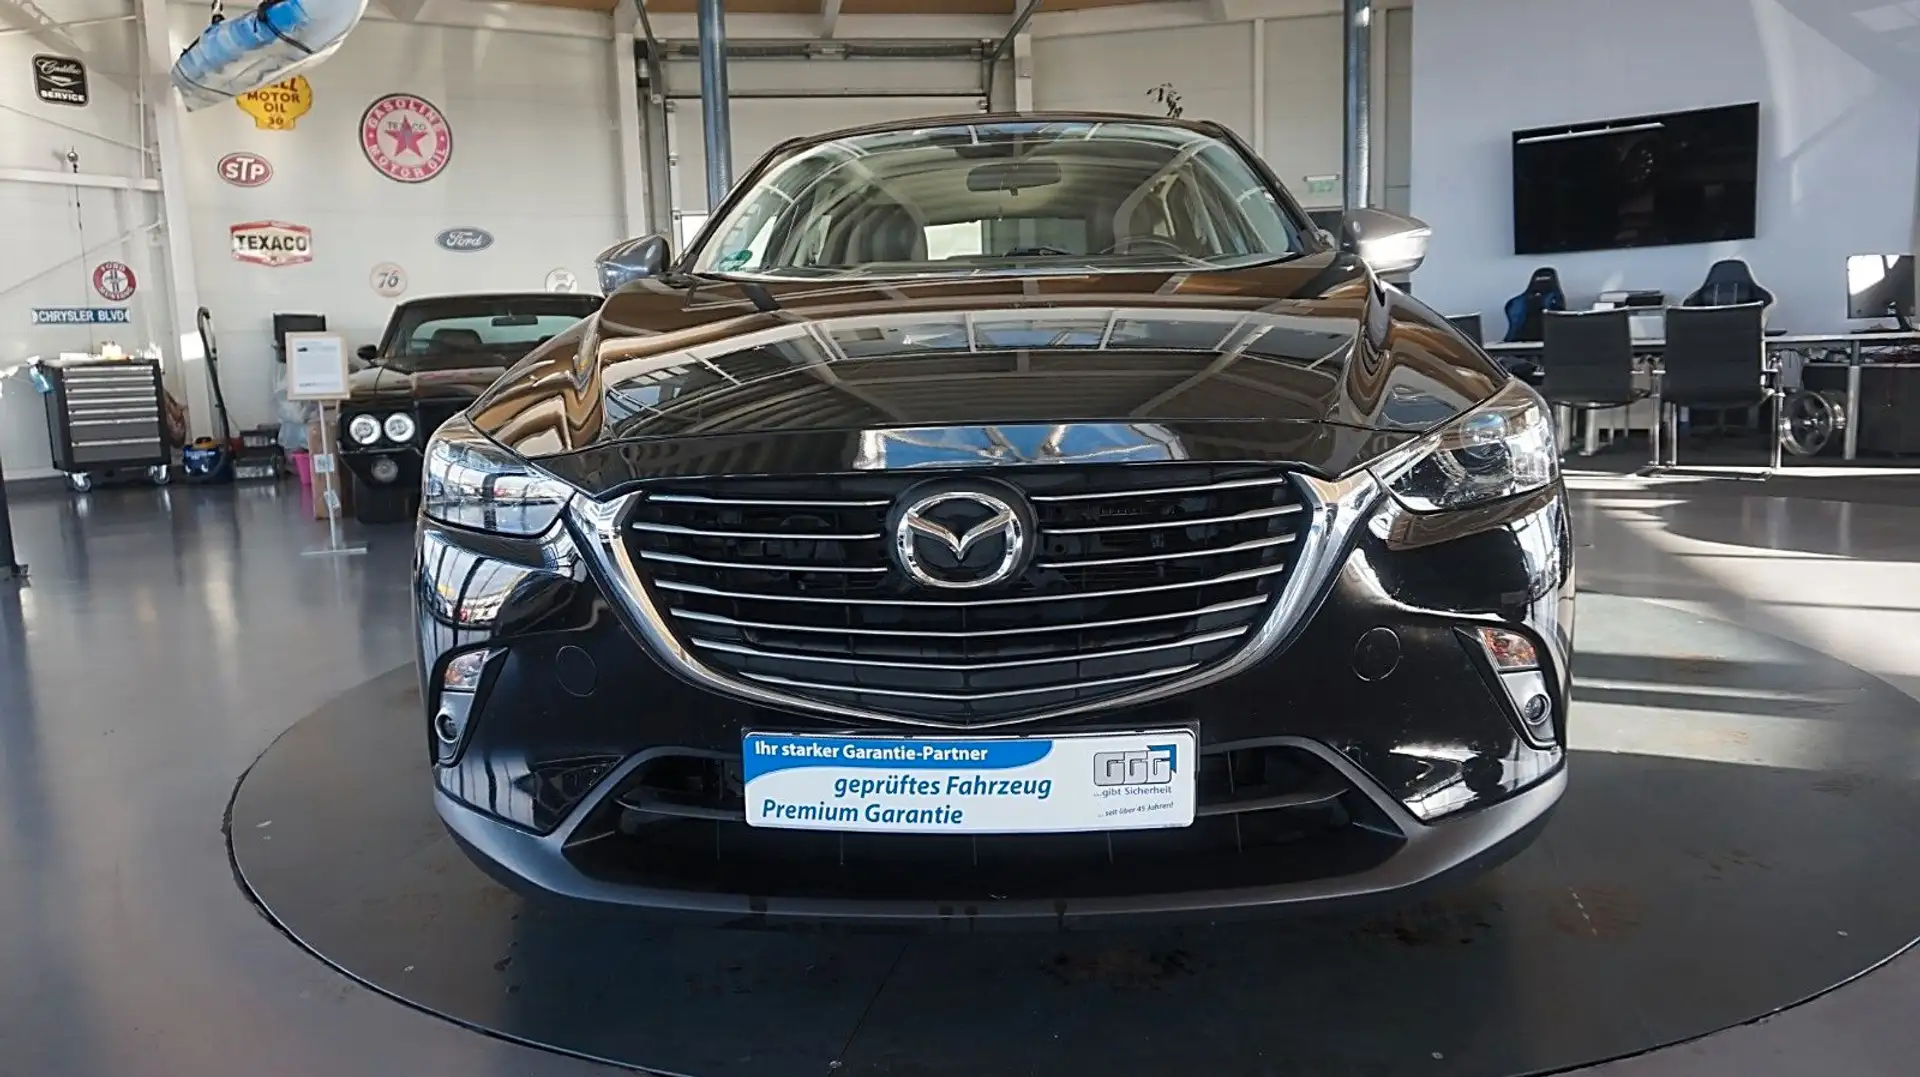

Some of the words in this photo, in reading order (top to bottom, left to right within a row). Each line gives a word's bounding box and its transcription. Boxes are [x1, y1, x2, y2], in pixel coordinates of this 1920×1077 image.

[41, 90, 85, 102] SERVICE
[247, 91, 300, 103] MOTOR
[263, 103, 287, 113] OIL
[225, 157, 265, 181] STP
[235, 234, 307, 251] TEXACO
[446, 231, 483, 247] Ford
[378, 269, 399, 288] 76
[39, 310, 95, 322] CHRYSLER
[98, 310, 124, 321] BLVD
[755, 740, 777, 756] Ihr
[782, 743, 839, 758] starker
[843, 744, 988, 761] Garantie-Partner
[834, 774, 941, 799] geprüftes
[946, 776, 1052, 799] Fahrzeug
[1124, 785, 1172, 795] Sicherheit
[762, 799, 859, 822] Premium
[865, 803, 964, 824] Garantie
